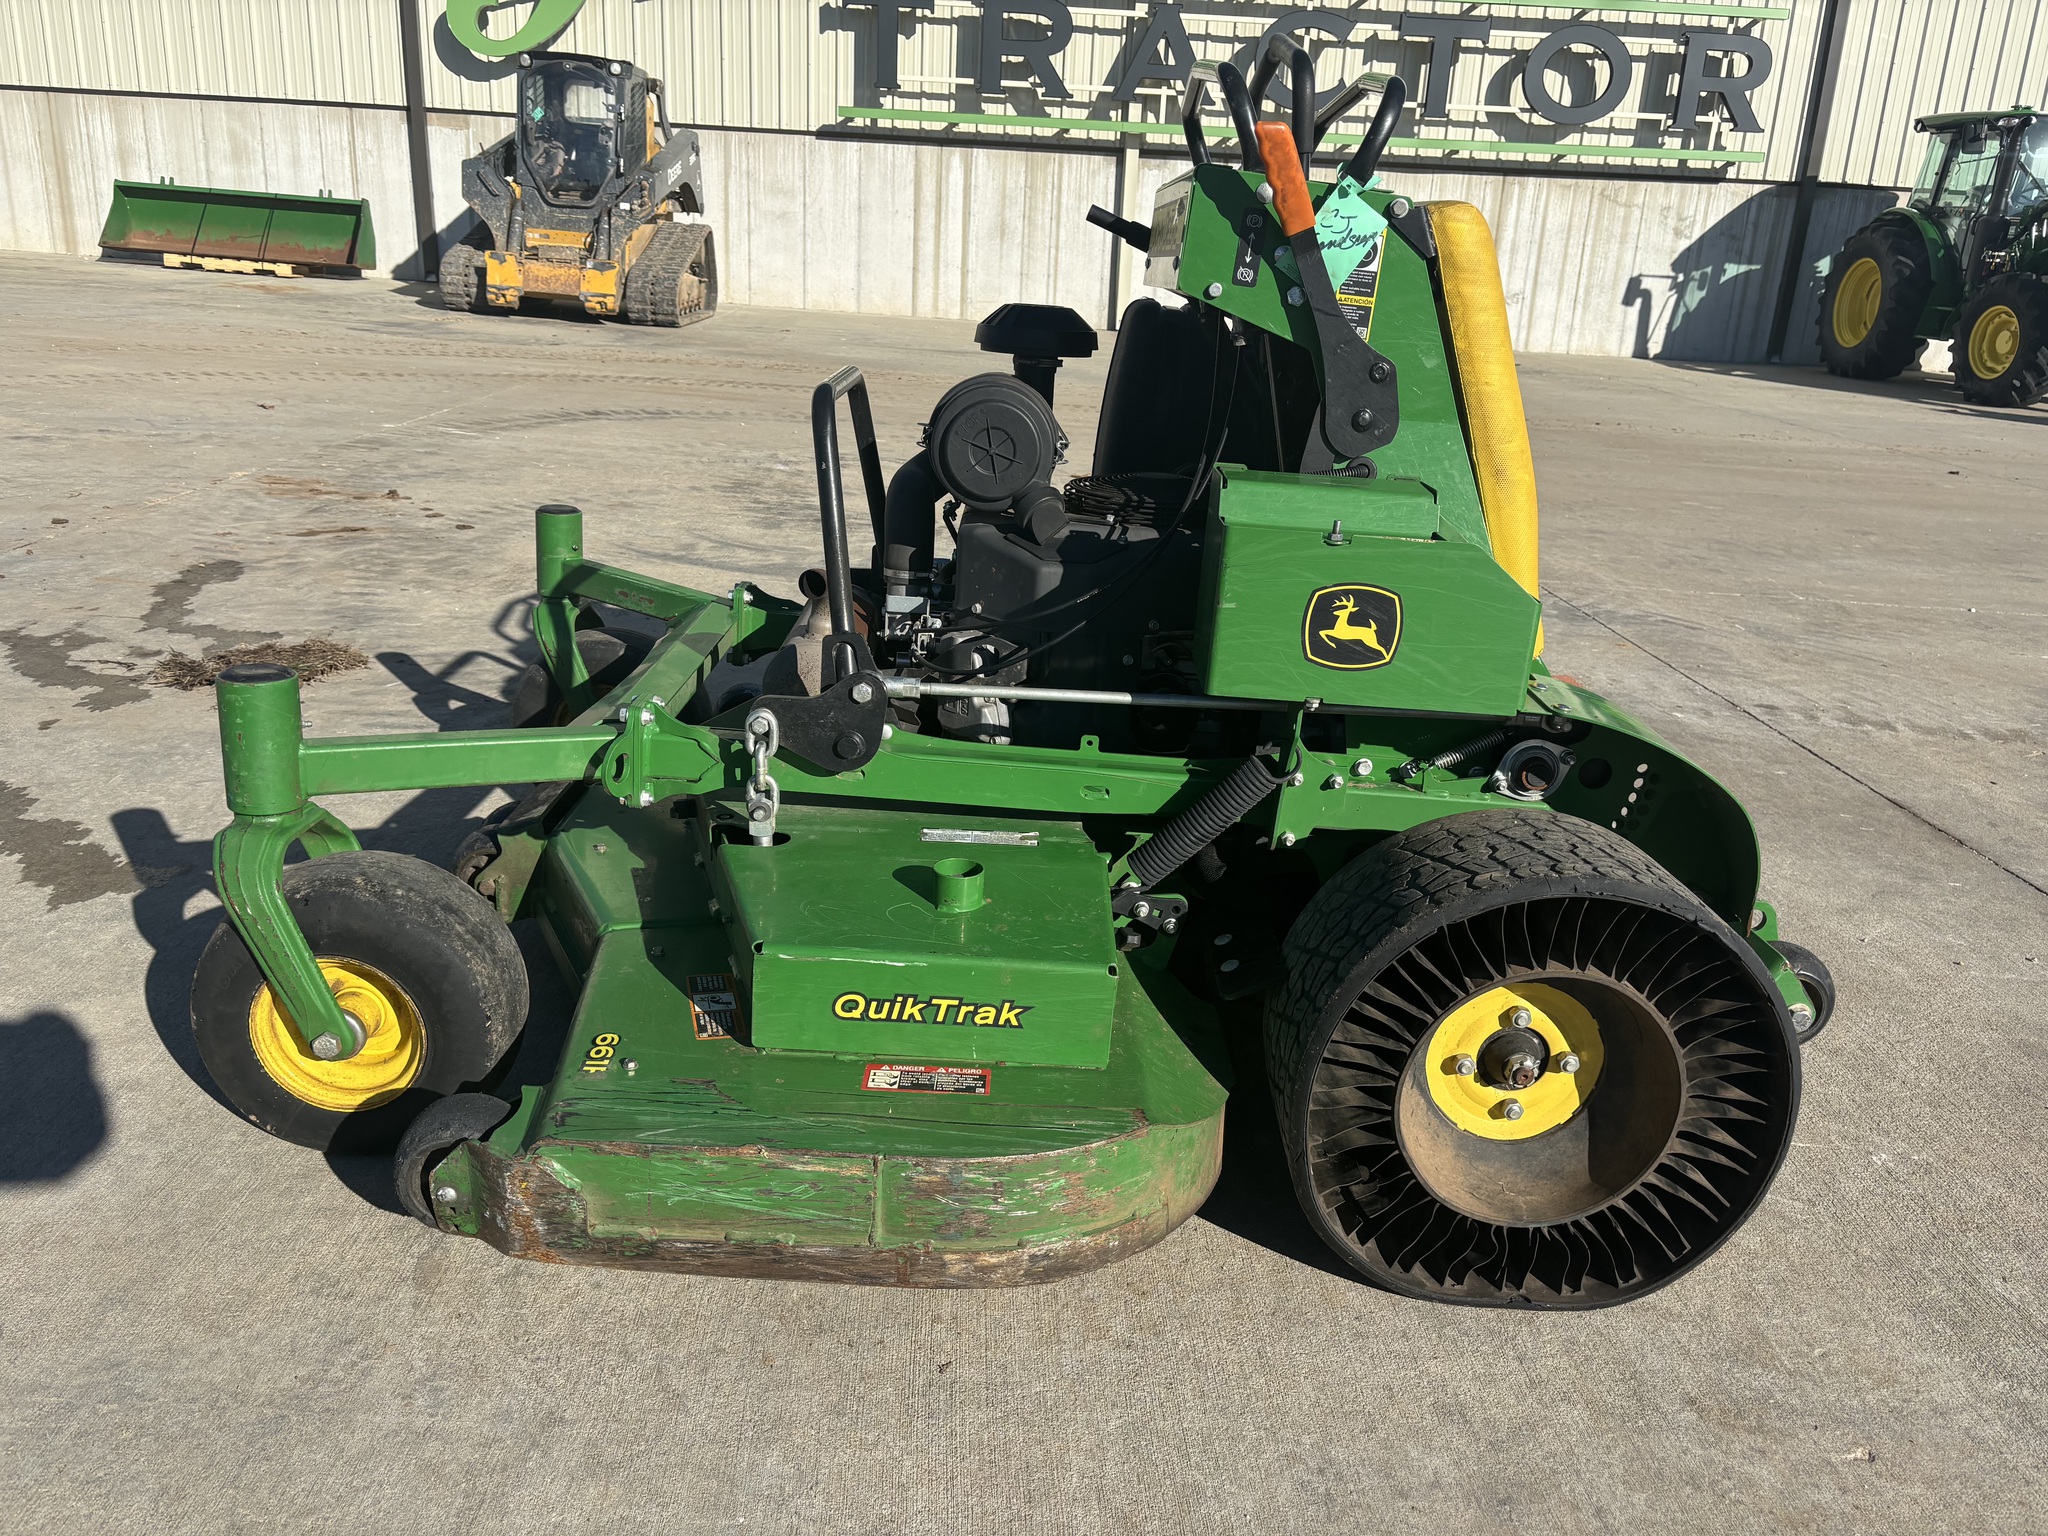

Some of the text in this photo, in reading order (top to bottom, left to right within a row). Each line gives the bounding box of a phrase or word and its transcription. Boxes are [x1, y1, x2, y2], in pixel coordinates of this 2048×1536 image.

[842, 0, 1772, 134] TRACTOR
[833, 993, 1026, 1027] QuikTrak
[948, 1067, 982, 1075] PELIGRO
